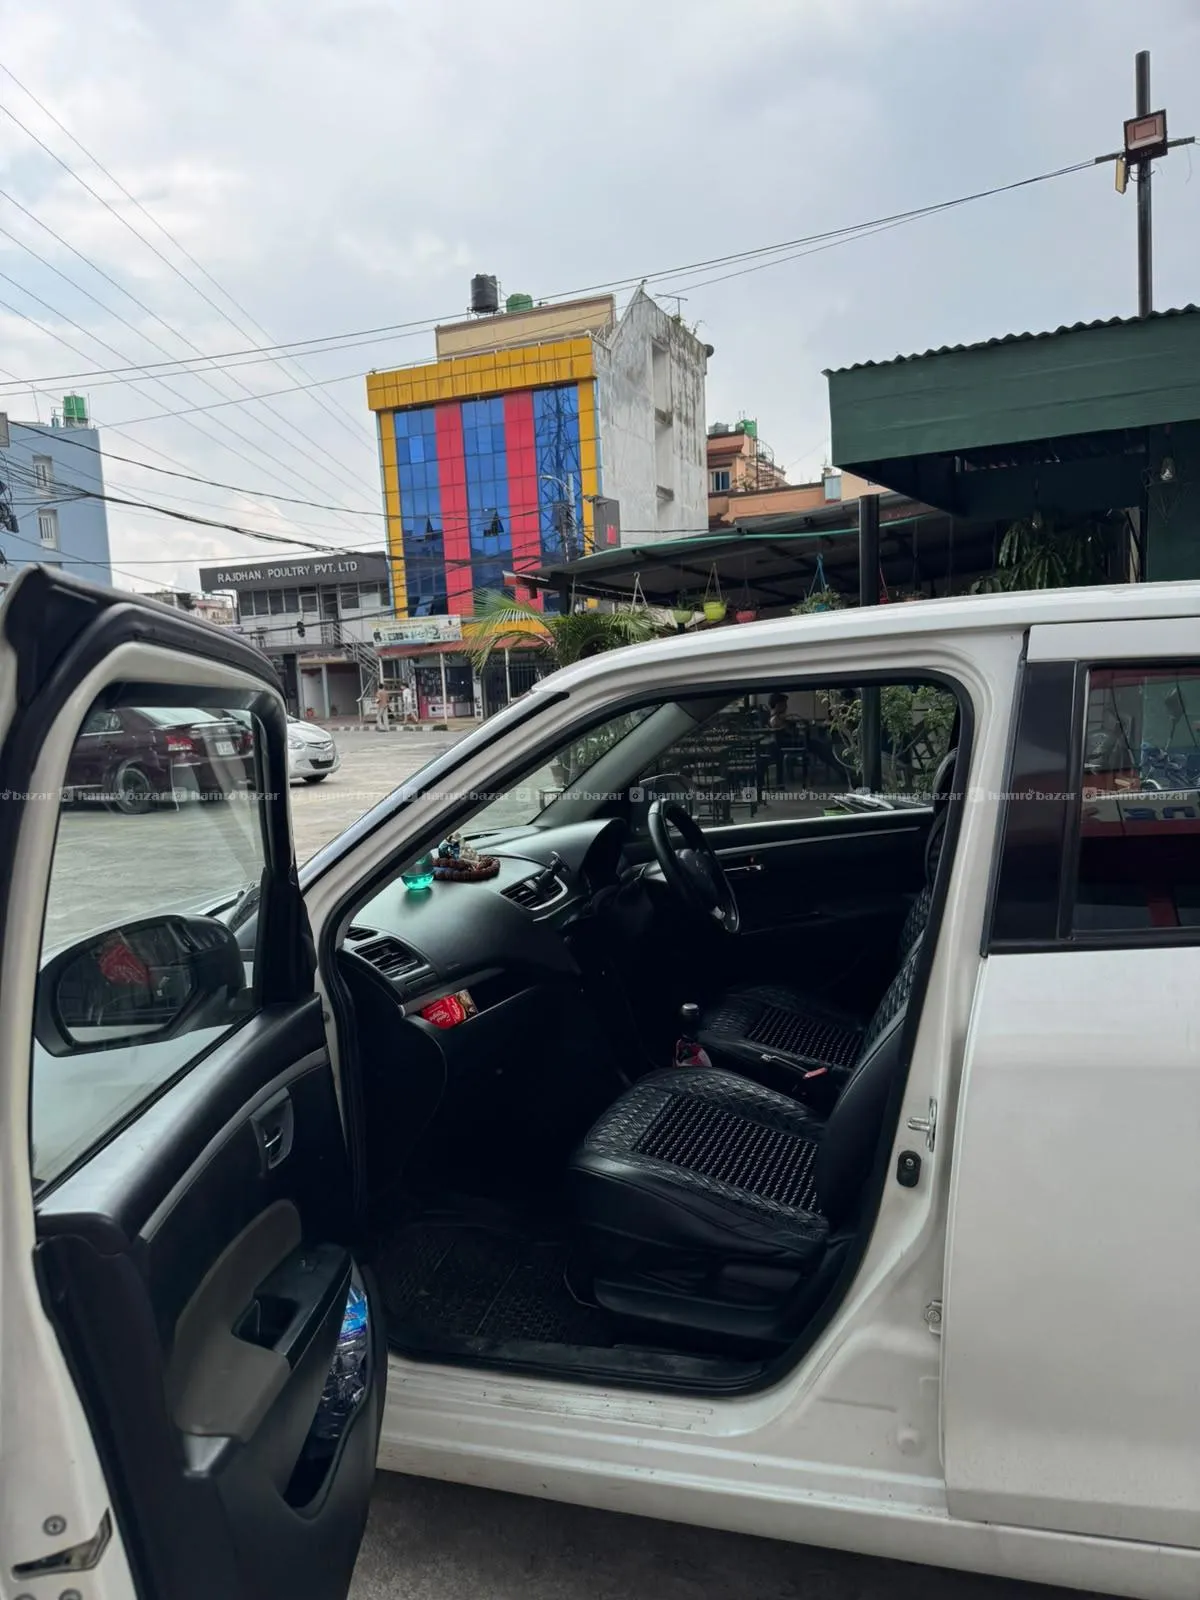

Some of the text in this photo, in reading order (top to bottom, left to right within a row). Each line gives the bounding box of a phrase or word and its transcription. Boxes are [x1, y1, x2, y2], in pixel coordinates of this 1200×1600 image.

[267, 565, 311, 579] POULTRY
[315, 562, 336, 575] PVT.
[339, 561, 358, 573] LTD
